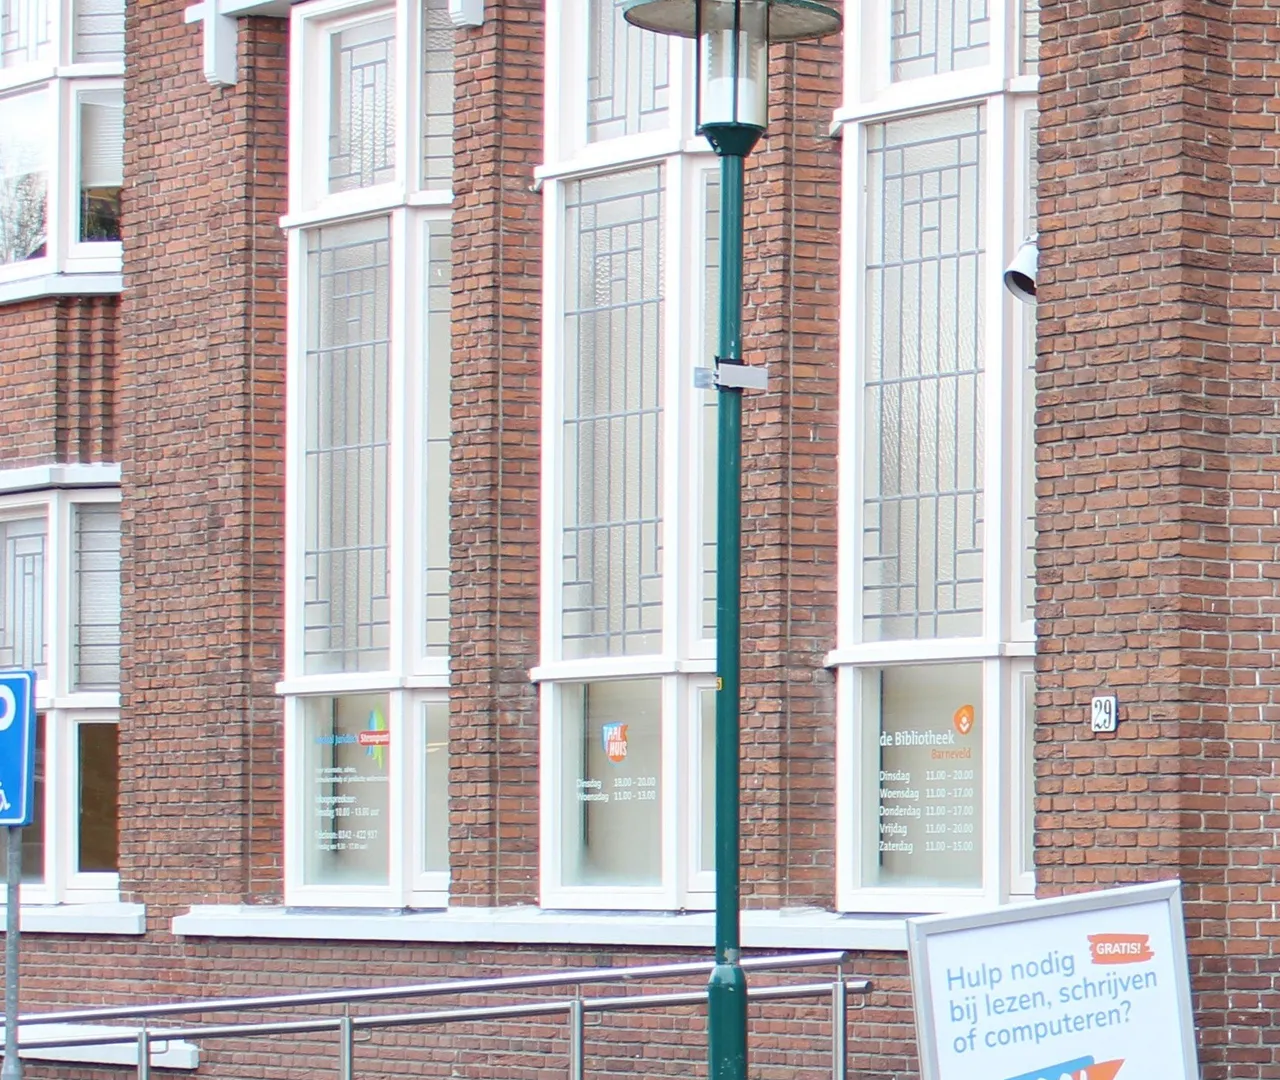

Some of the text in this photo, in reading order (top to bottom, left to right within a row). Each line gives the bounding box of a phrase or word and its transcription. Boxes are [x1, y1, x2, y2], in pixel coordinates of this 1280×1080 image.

[1094, 699, 1112, 729] 29
[880, 730, 955, 746] de Bibliotheek
[609, 741, 627, 756] HUIS
[931, 747, 972, 759] Barneveld
[879, 770, 910, 783] Dinsdag
[926, 770, 945, 780] 11.00
[953, 770, 973, 780] 20.00
[880, 788, 919, 800] Woensdag
[926, 788, 945, 798] 11.00
[953, 788, 973, 797] 17.00
[879, 805, 921, 818] Donderdag
[926, 806, 945, 816] 11.00
[953, 806, 973, 815] 17.00
[879, 823, 907, 836] Vrijdag
[926, 824, 945, 833] 11.00
[953, 823, 973, 833] 20.00
[879, 841, 913, 854] Zaterdag
[926, 842, 945, 851] 11.00
[953, 841, 973, 851] 15.00
[1096, 942, 1142, 955] GRATIS!
[946, 951, 1076, 991] Hulp nodig
[950, 970, 1158, 1025] bij lezen, schrijven
[953, 1001, 1132, 1053] of computeren?
